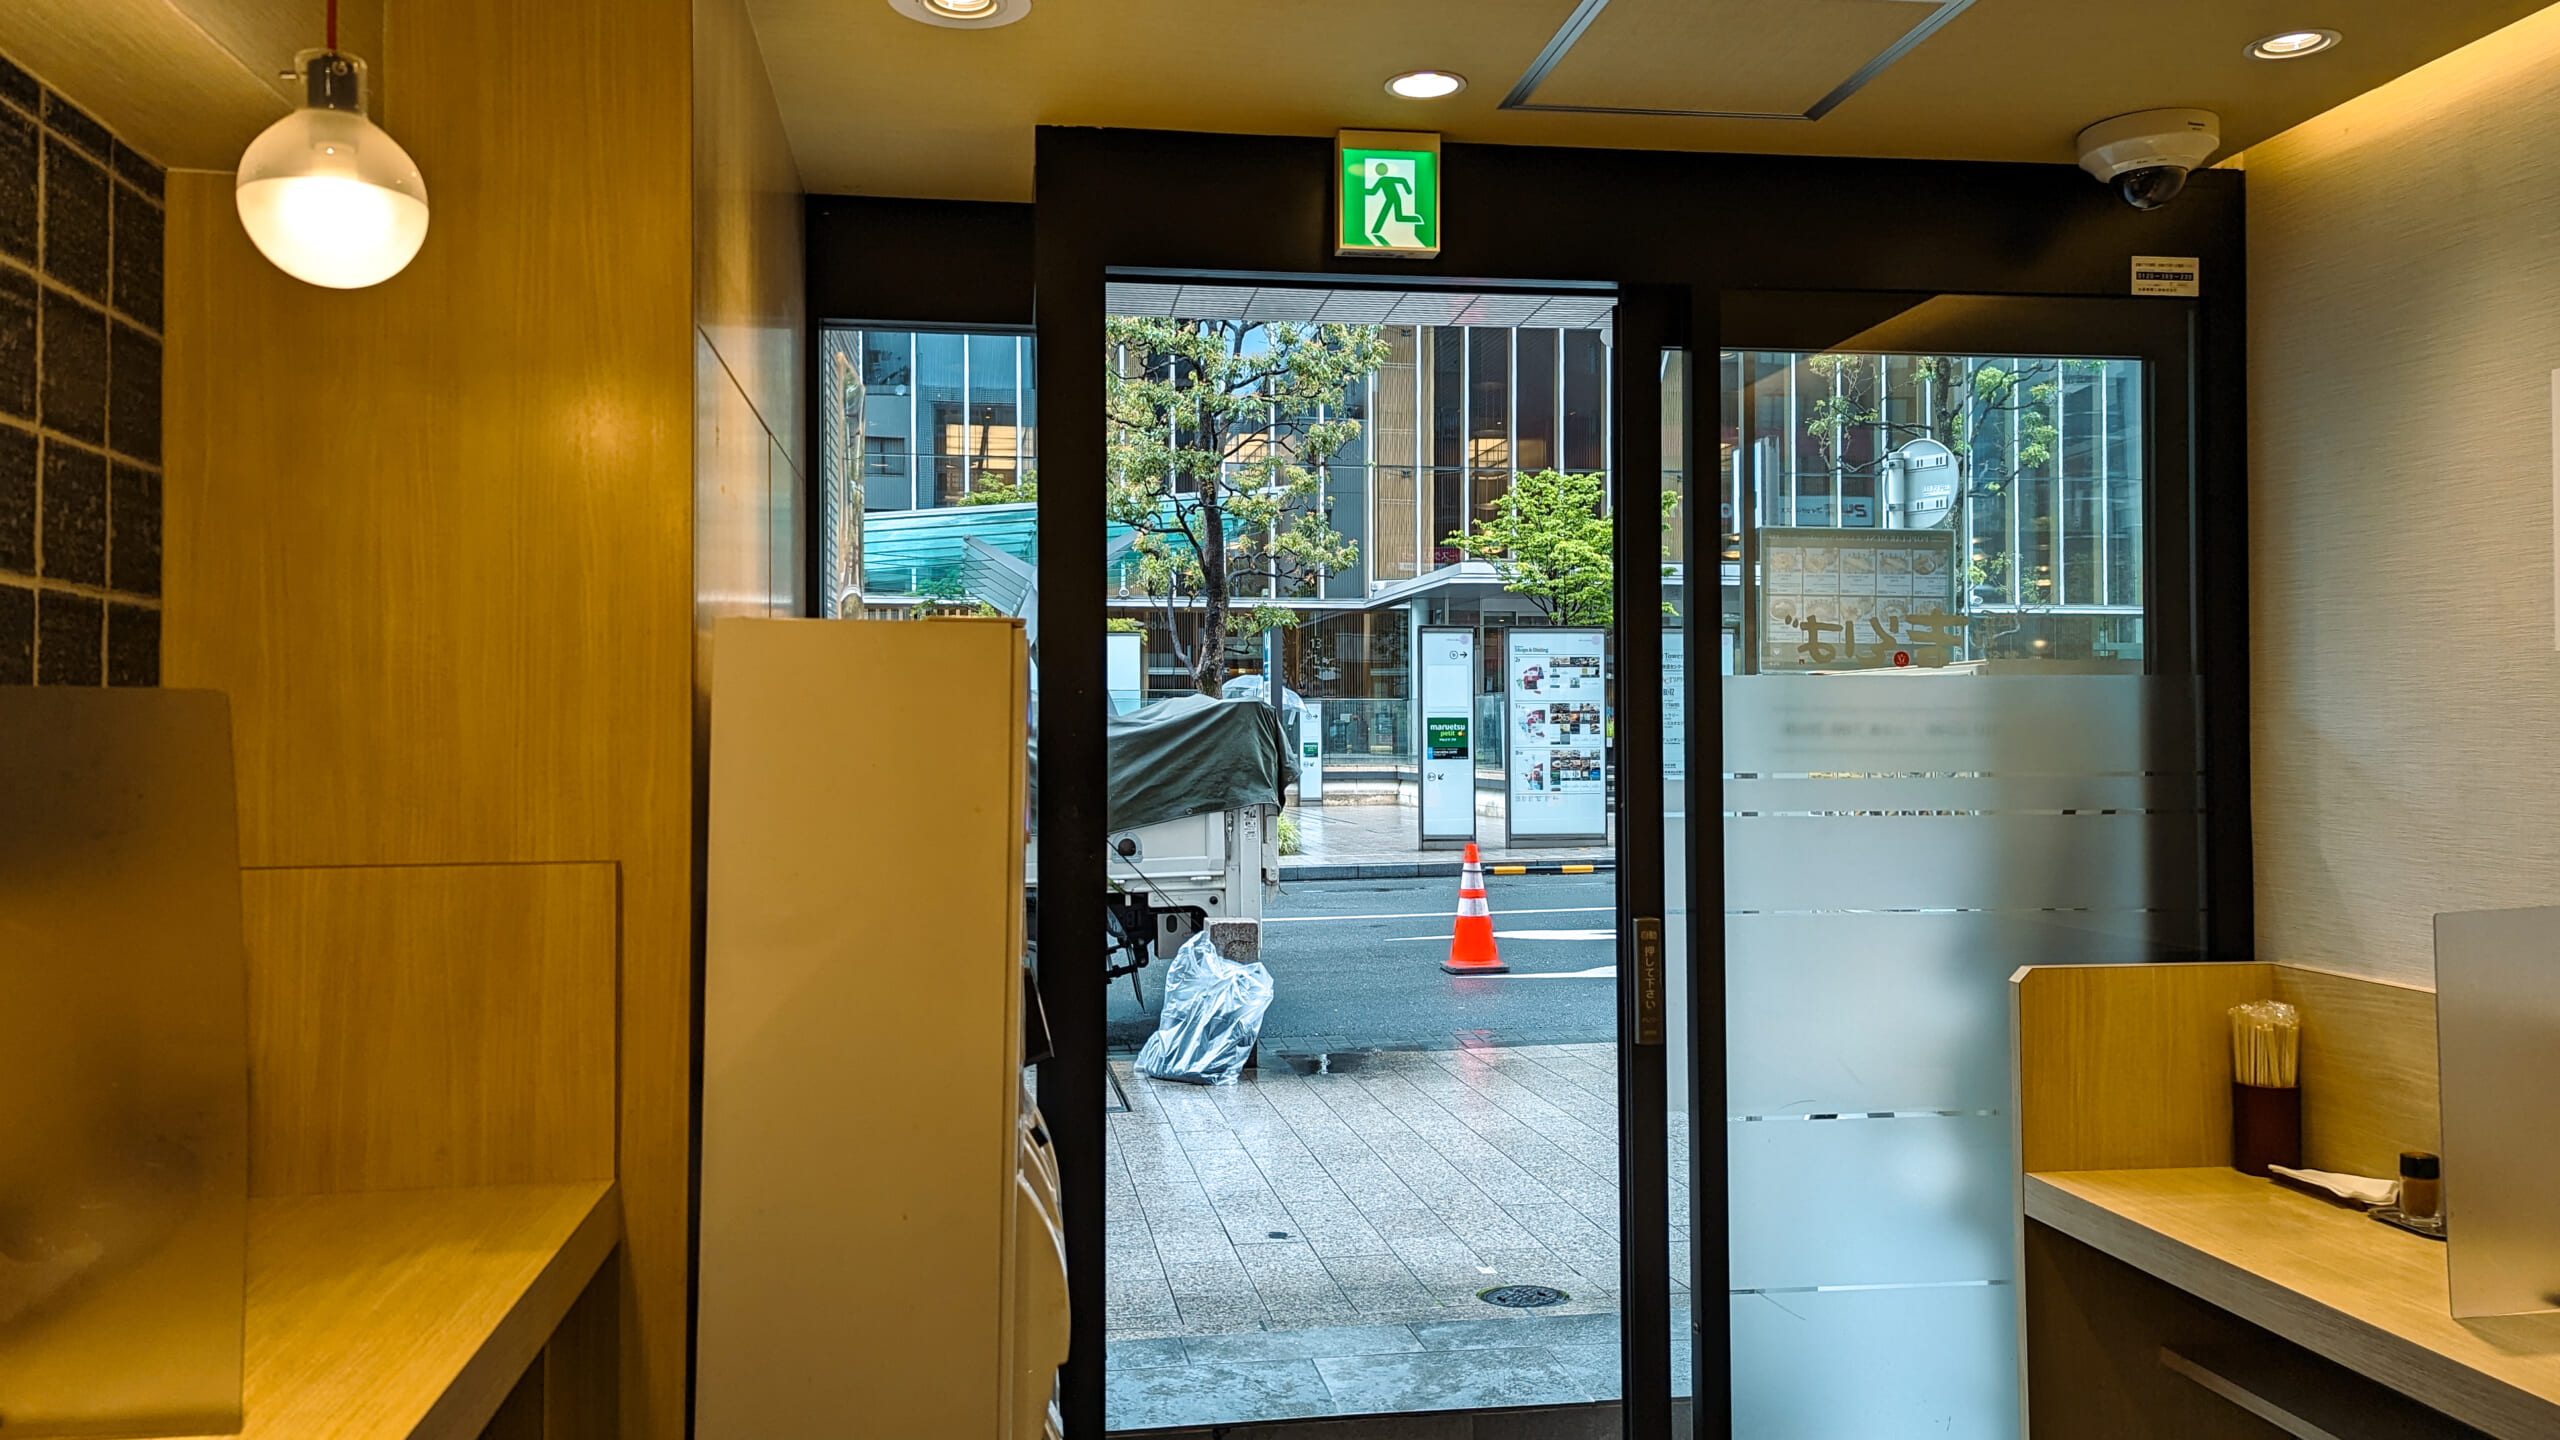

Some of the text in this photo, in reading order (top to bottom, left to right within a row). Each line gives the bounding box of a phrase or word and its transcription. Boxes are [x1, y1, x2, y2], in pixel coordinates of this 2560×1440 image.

[1644, 946, 1656, 1009] 押して下さい
